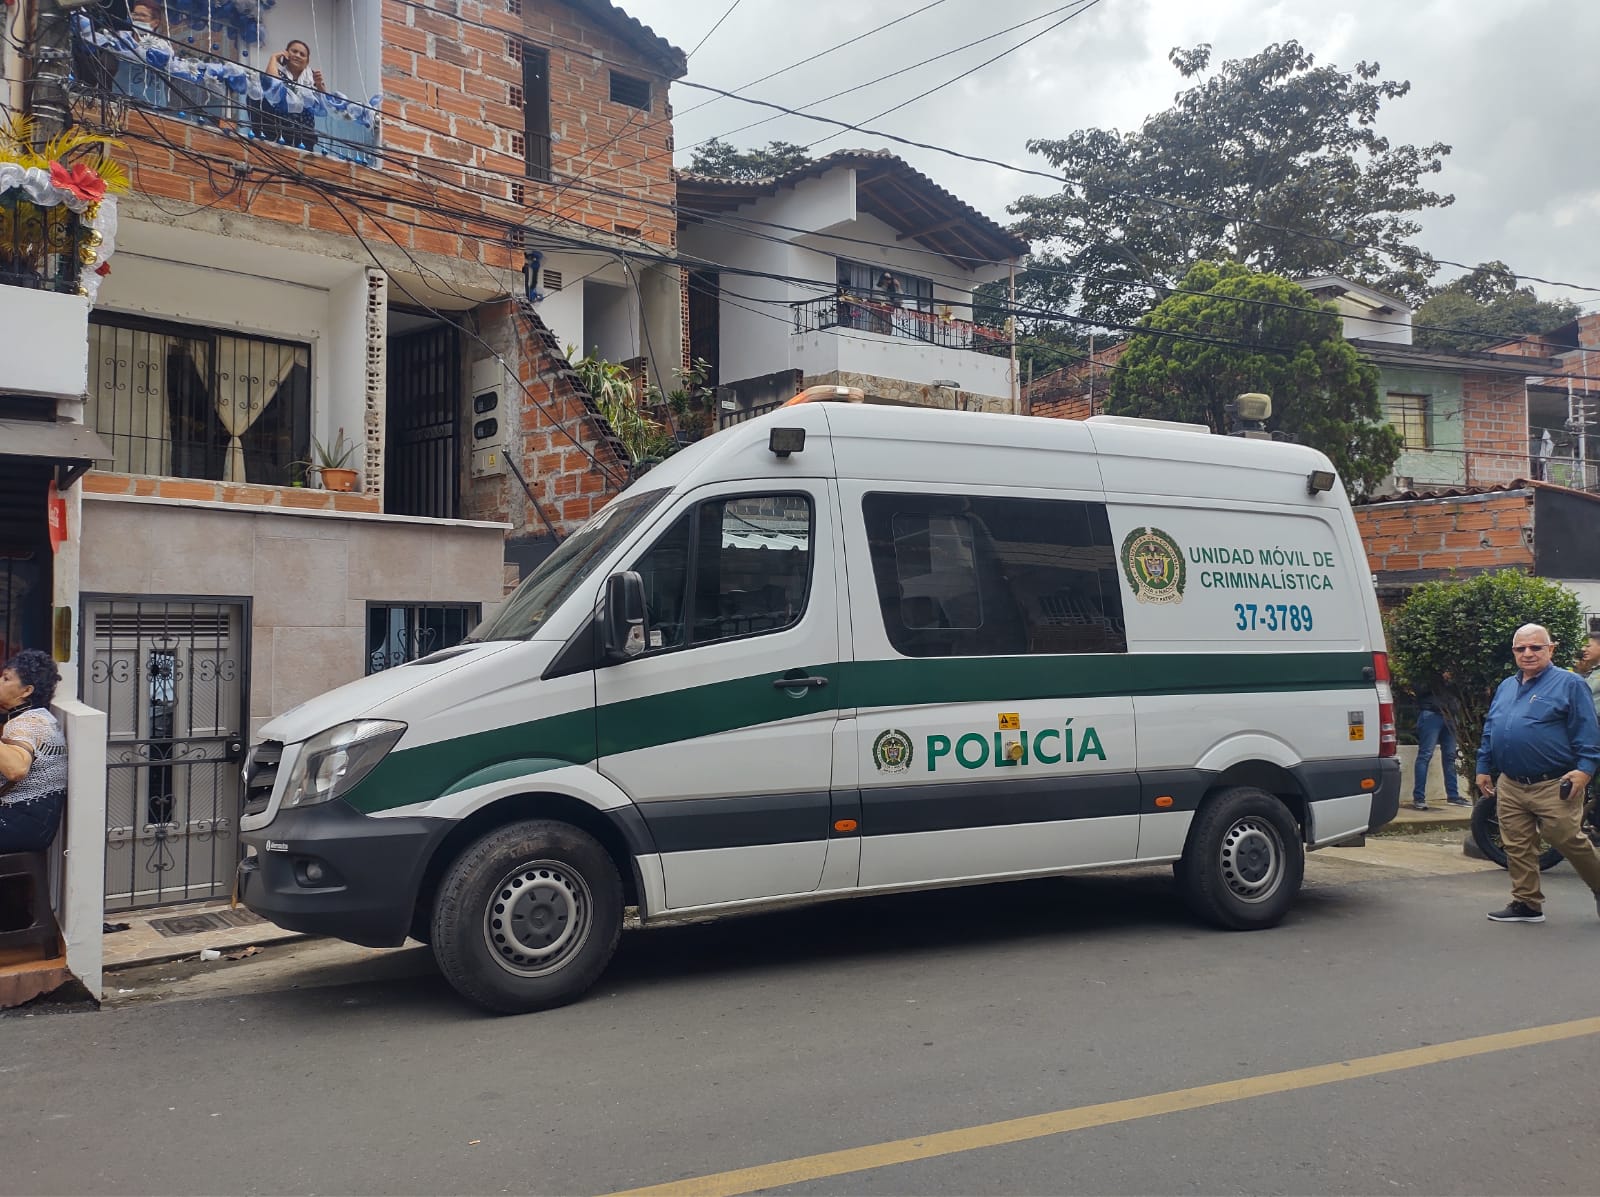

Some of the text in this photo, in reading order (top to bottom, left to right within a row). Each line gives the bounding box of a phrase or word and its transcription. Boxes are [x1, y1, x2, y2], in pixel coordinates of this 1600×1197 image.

[1188, 545, 1335, 568] UNIDAD MÓVIL DE
[1200, 569, 1334, 591] CRIMINALÍSTICA
[1234, 602, 1313, 632] 37-3789
[926, 717, 1107, 772] POLICÍA
